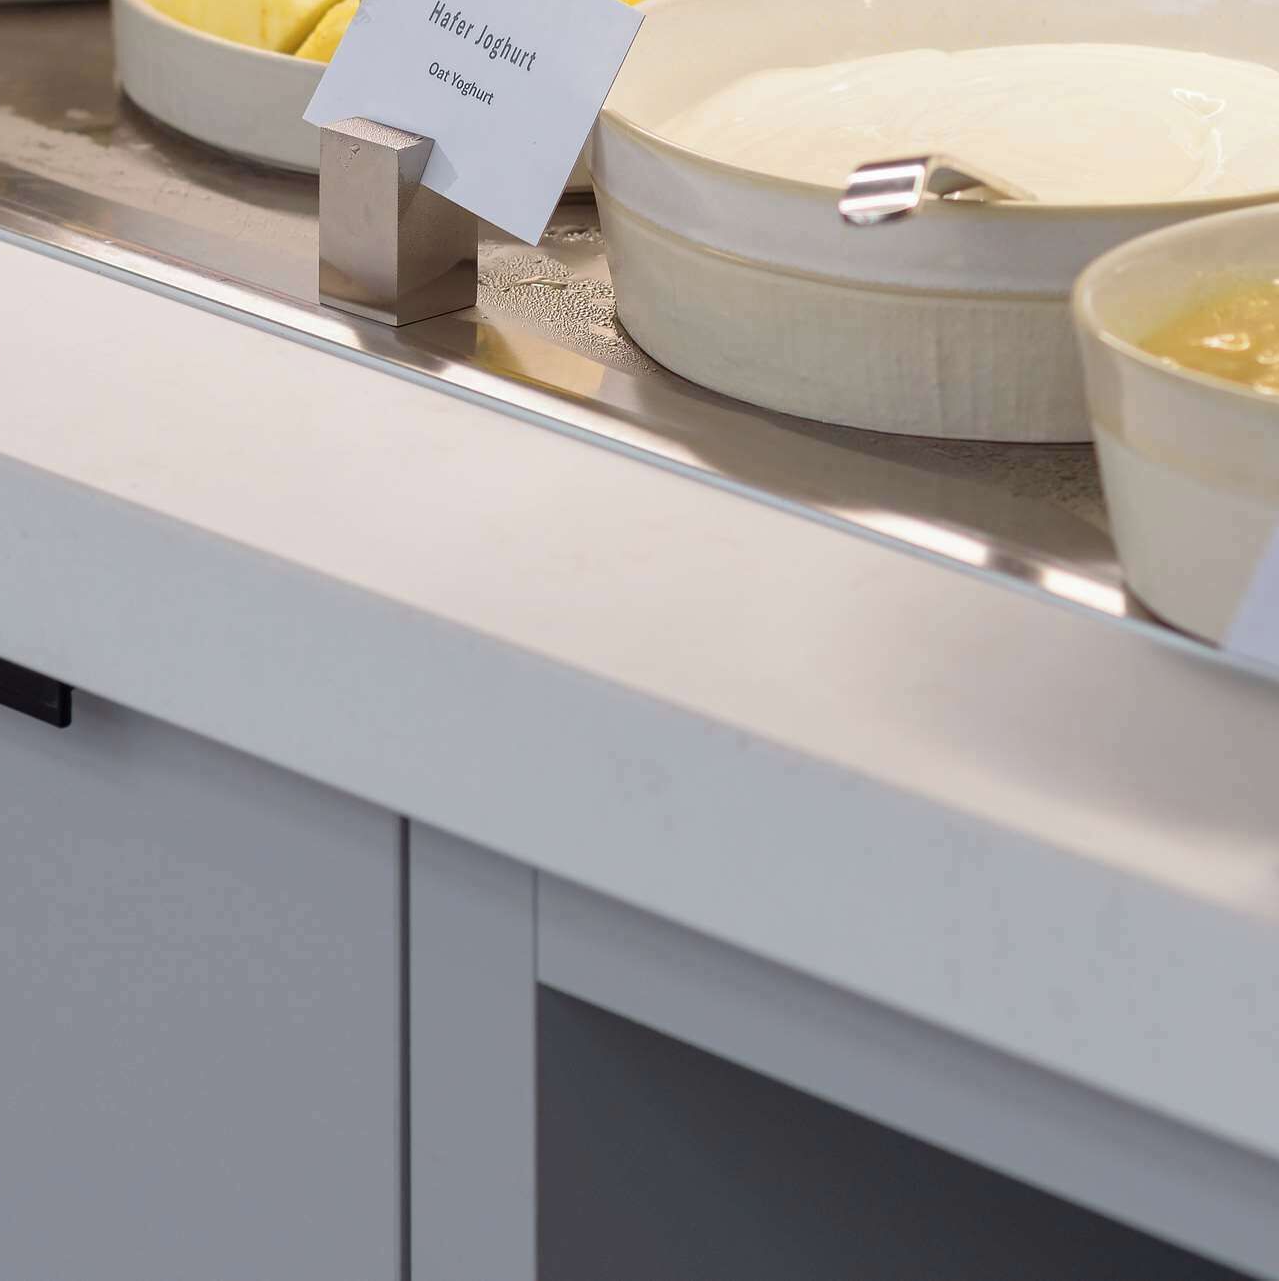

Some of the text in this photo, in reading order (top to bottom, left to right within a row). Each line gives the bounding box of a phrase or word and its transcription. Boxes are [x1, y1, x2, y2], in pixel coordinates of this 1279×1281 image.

[428, 0, 537, 72] Hafer Joghurt
[428, 61, 494, 106] Oat Yoghurt
